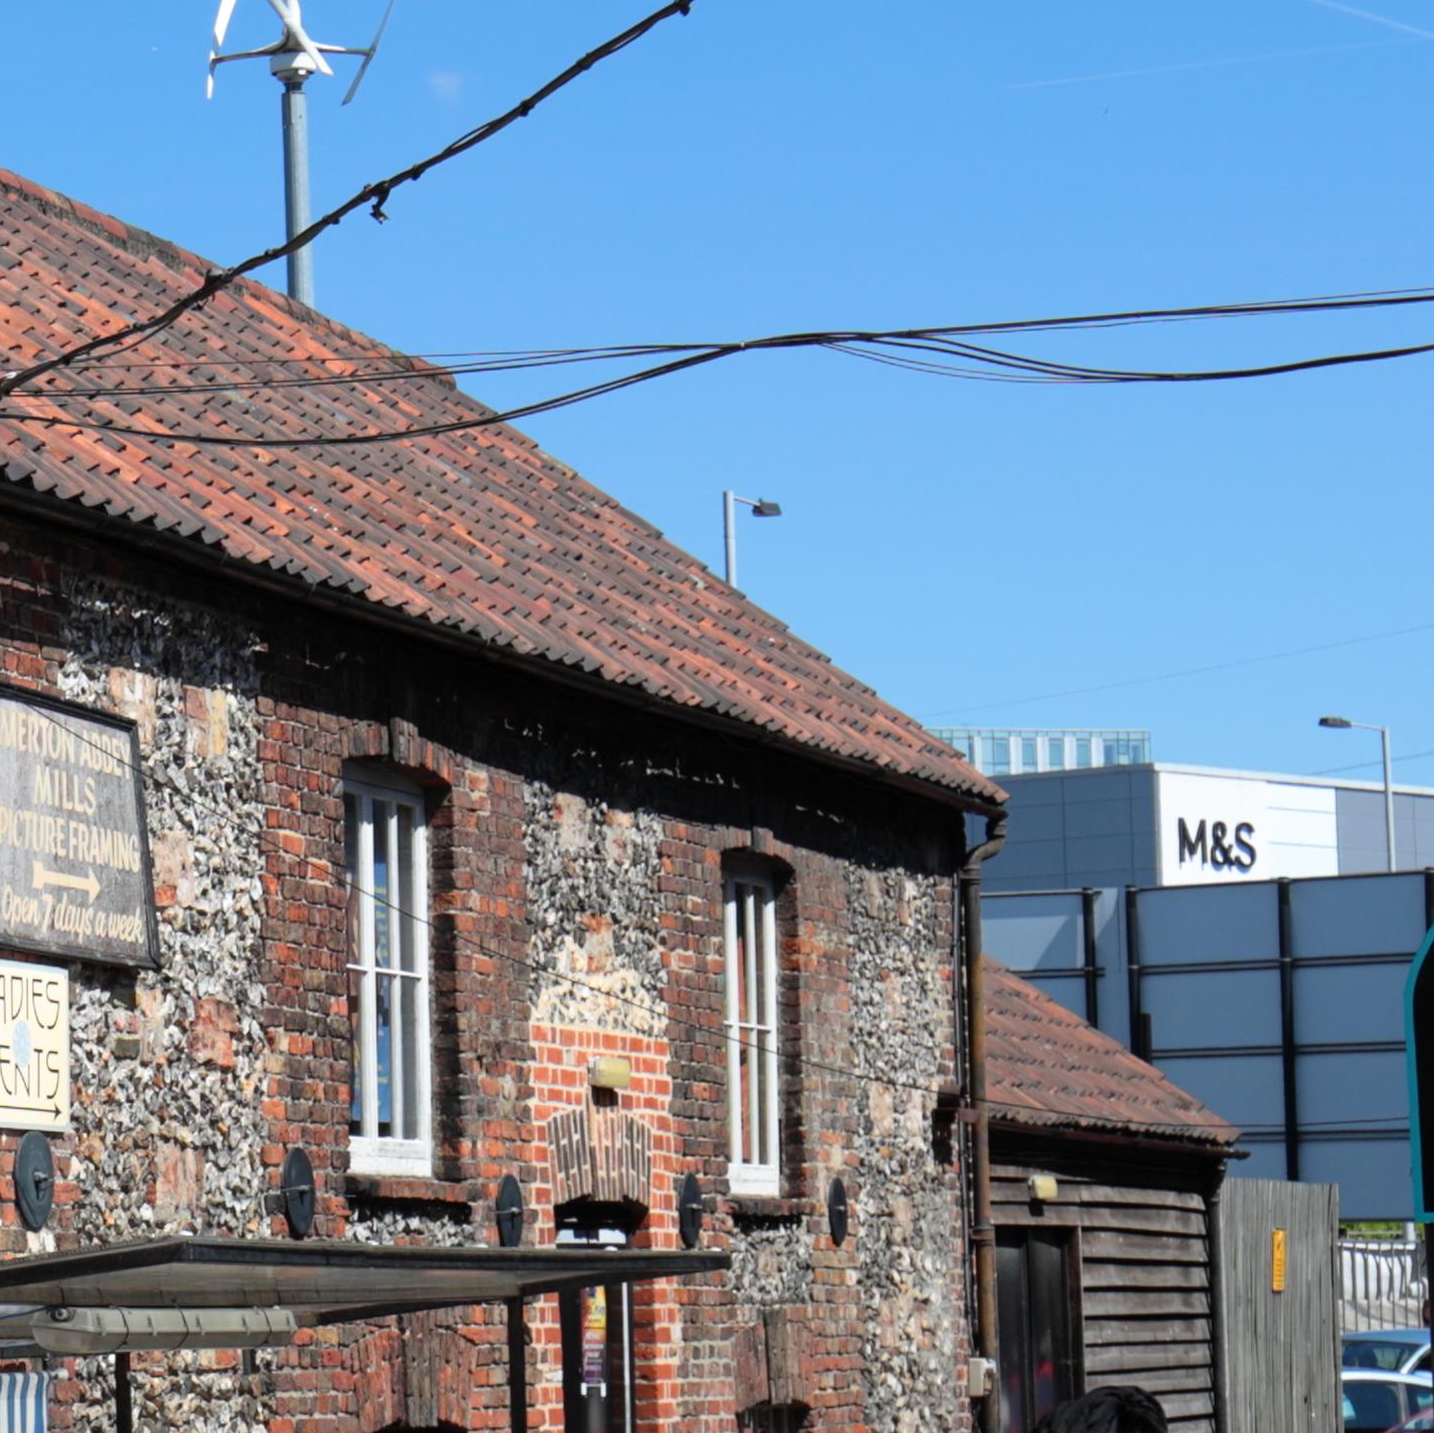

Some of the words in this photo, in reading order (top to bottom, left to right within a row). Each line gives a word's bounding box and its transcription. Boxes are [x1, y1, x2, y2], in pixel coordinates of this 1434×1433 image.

[80, 729, 131, 779] ABBEY
[32, 766, 96, 815] MILLS
[69, 820, 140, 872] FRAMING
[1178, 818, 1256, 867] M&S
[2, 889, 39, 929] Open
[54, 896, 96, 943] days
[107, 909, 145, 944] week
